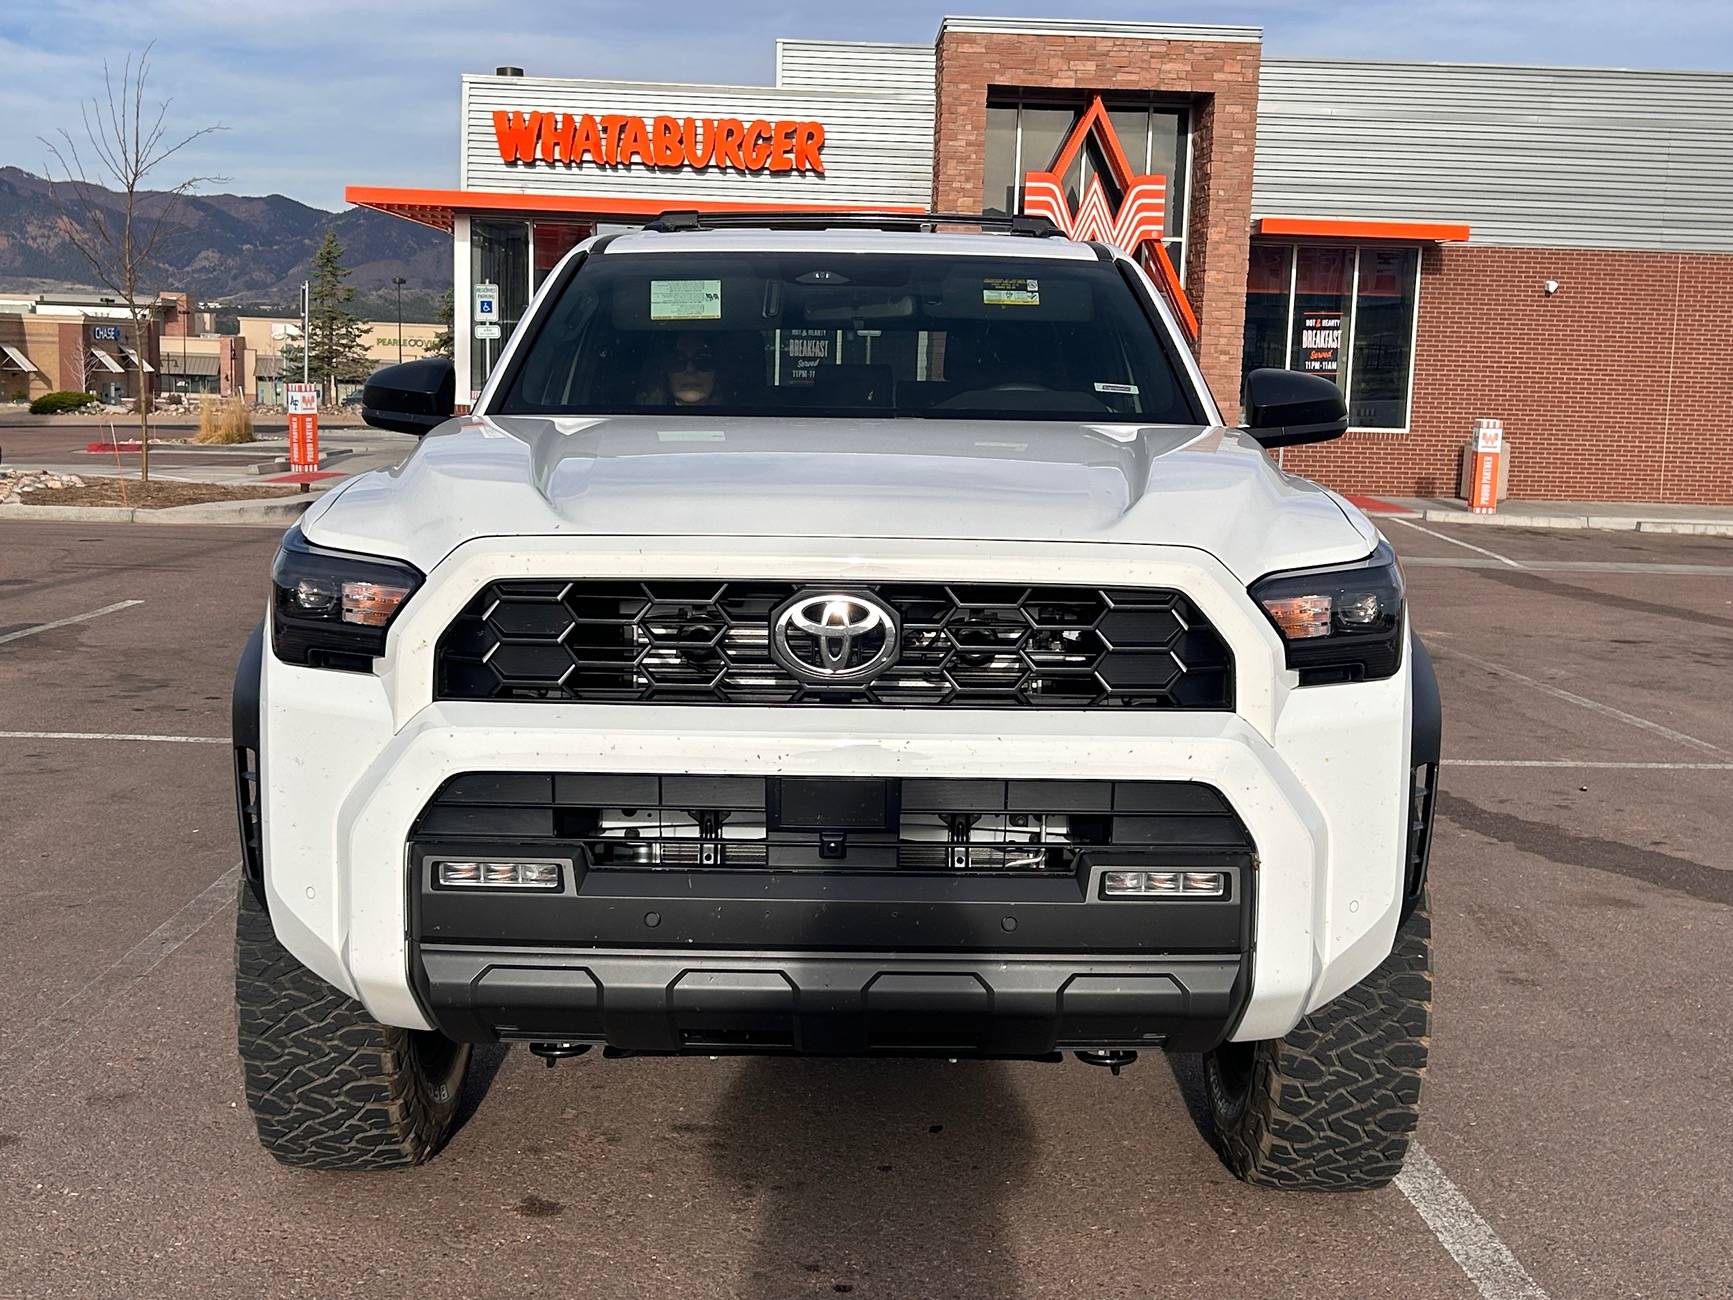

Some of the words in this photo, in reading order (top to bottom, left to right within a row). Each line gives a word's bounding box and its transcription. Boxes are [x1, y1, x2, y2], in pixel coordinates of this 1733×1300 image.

[493, 111, 826, 173] WHATABURGER
[1322, 319, 1341, 327] HEARTY
[95, 327, 115, 340] CHASE
[1302, 329, 1342, 349] BREAKFAST
[789, 339, 829, 358] BREAKFAST
[305, 416, 313, 442] PARTNER
[1482, 456, 1493, 484] PARTNER
